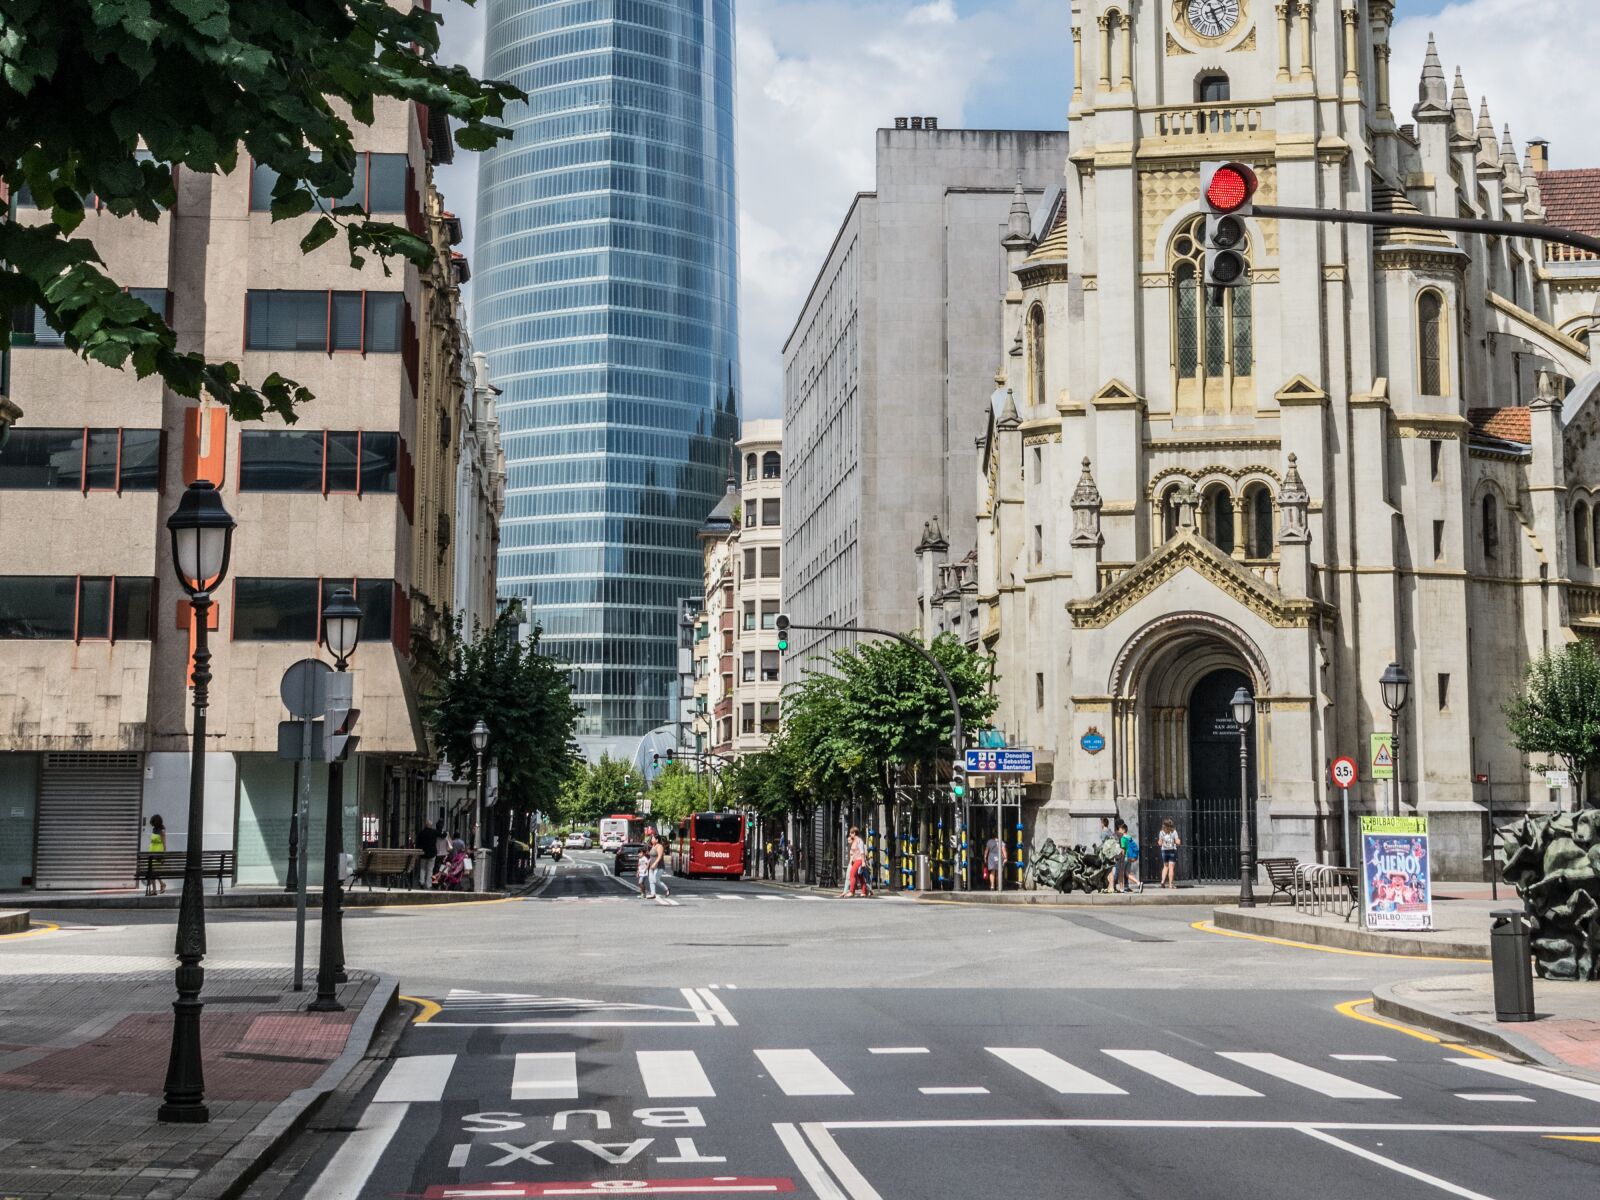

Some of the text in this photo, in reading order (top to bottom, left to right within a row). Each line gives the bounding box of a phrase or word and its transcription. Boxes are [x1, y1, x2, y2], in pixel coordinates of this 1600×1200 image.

[1372, 817, 1396, 826] BILBAO
[704, 850, 730, 858] Bilbobus
[1374, 851, 1421, 877] SUEÑOS
[1377, 913, 1401, 921] BILBO
[461, 1106, 707, 1133] BUS
[447, 1137, 728, 1168] TAXI
